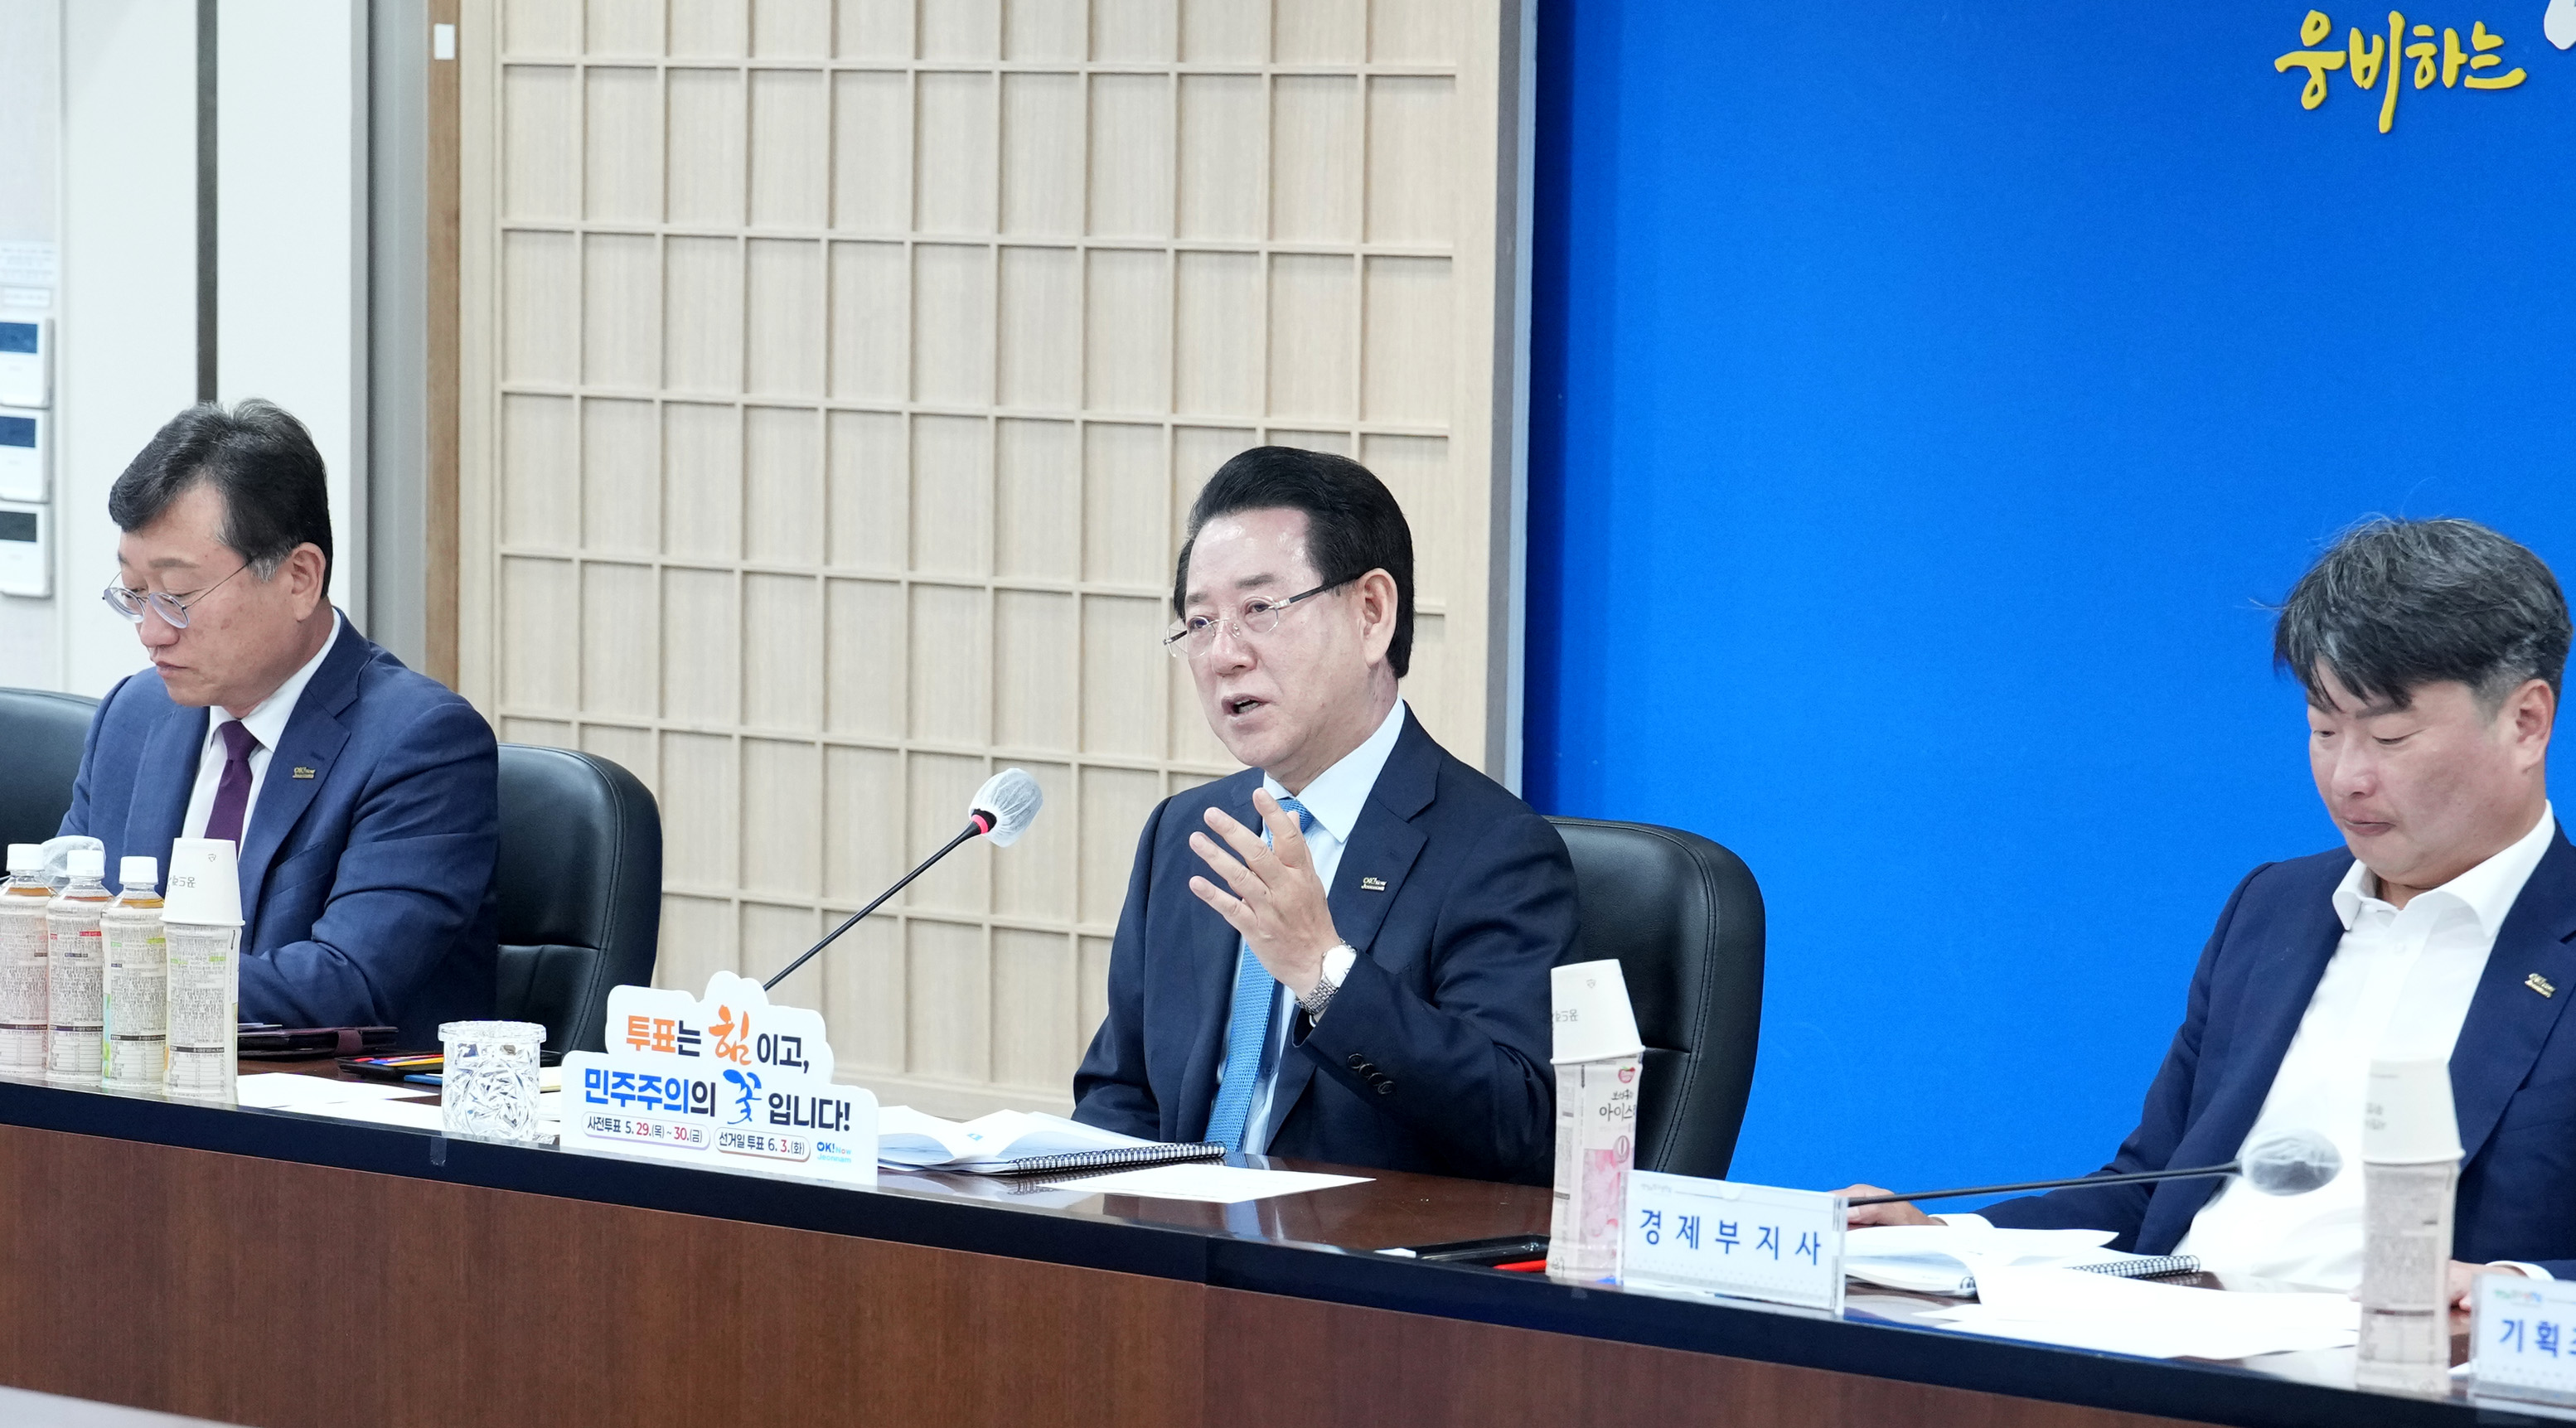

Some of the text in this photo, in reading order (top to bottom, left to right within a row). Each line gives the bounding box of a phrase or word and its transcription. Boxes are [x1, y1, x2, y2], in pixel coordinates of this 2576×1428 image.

[2274, 9, 2526, 133] 웅비하는
[626, 1015, 701, 1057] 투표는
[584, 1068, 715, 1117] 민주주의의
[588, 1116, 621, 1133] 사전투표
[719, 1131, 744, 1148] 선거일
[748, 1135, 764, 1150] 투표
